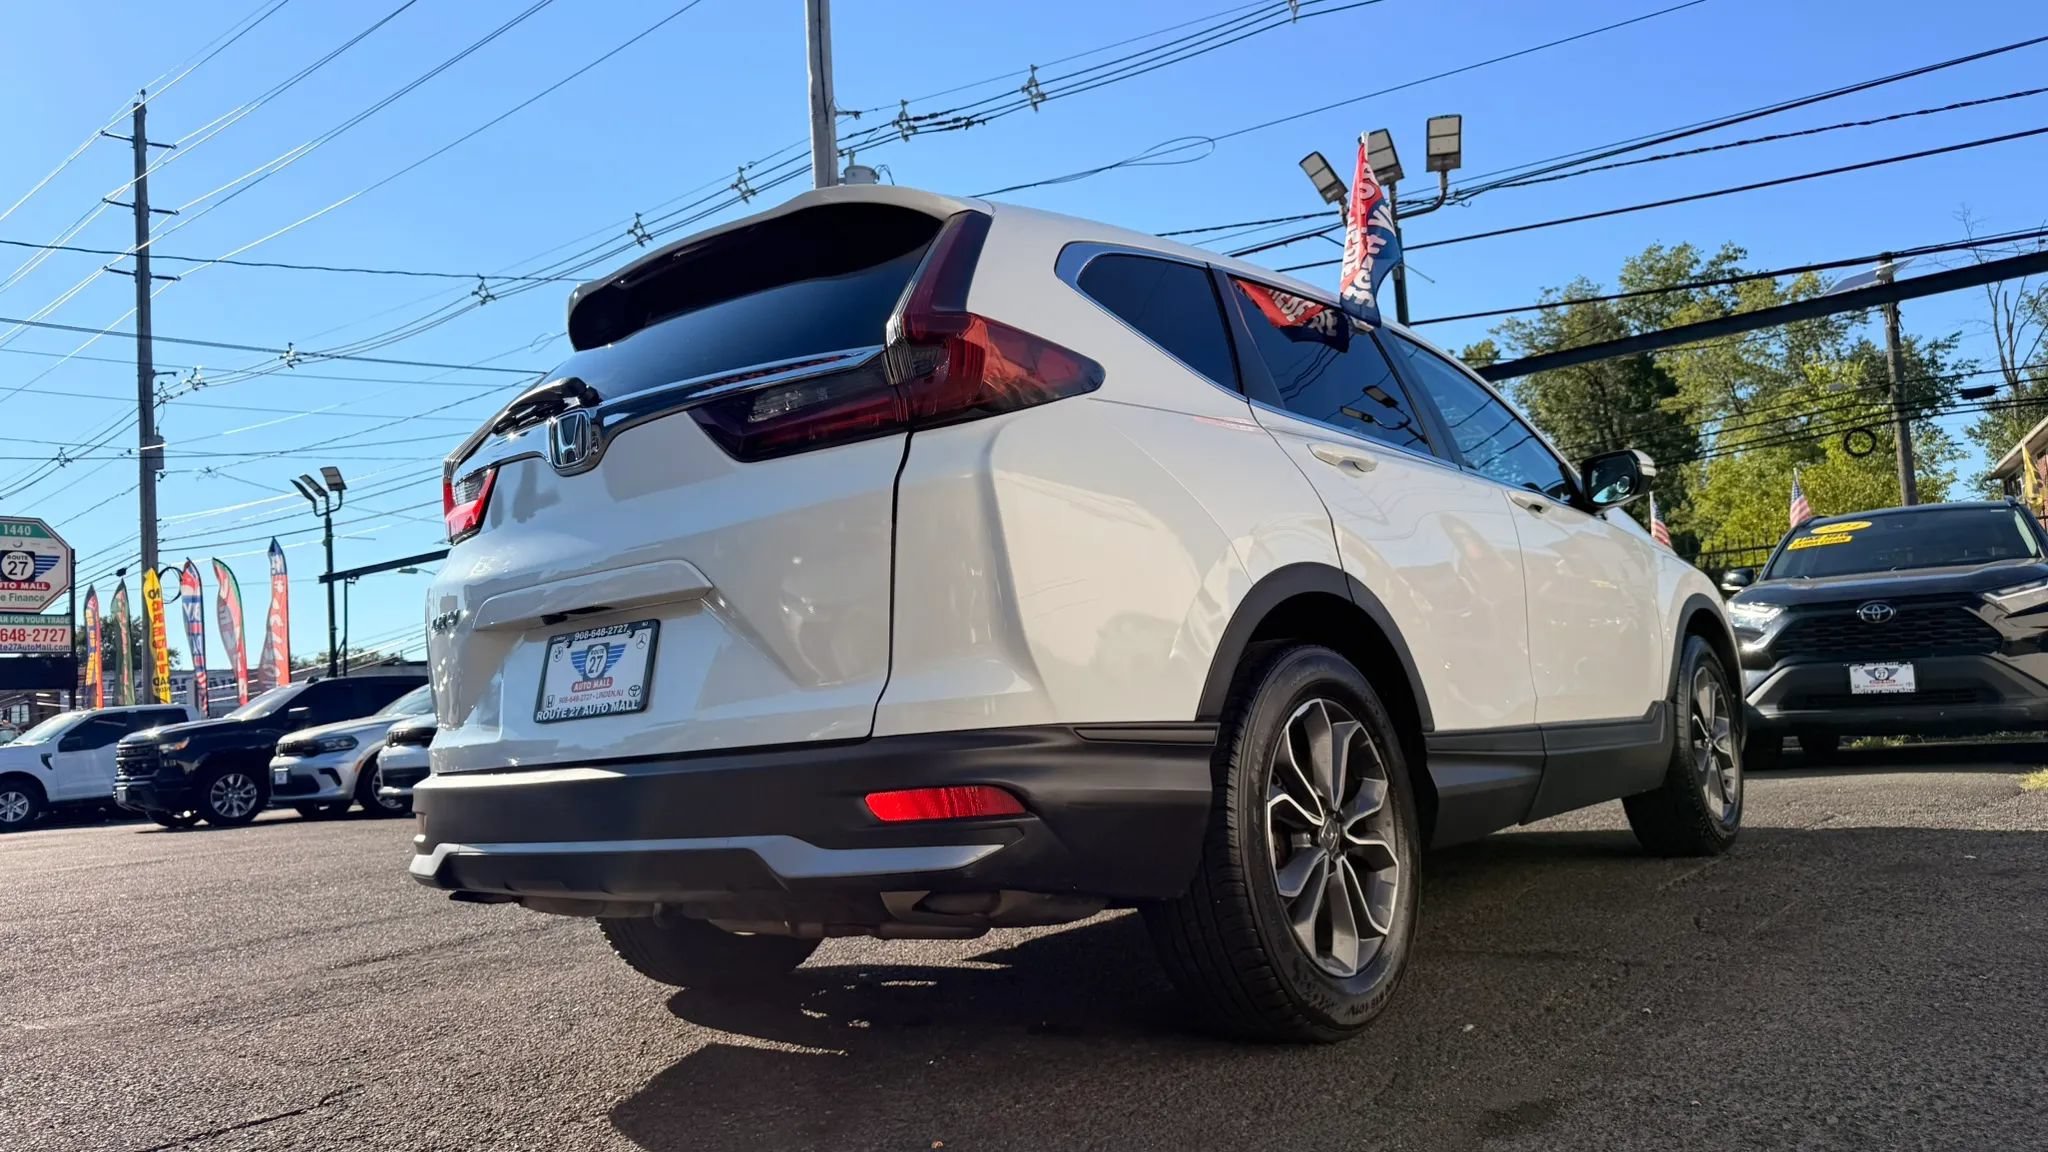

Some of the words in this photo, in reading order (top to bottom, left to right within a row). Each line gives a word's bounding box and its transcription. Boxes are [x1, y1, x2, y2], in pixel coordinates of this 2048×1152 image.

[4, 524, 31, 536] 1440
[8, 561, 28, 576] 27
[9, 592, 45, 601] Finance
[10, 616, 24, 624] FOR
[26, 616, 45, 624] YOUR
[0, 628, 66, 642] 648-2727
[574, 624, 629, 641] 908-648-2727
[590, 648, 605, 656] ROUTE
[588, 655, 603, 674] 27
[573, 682, 591, 691] AUTO
[592, 679, 611, 689] MALL
[536, 709, 570, 721] ROUTE
[570, 707, 581, 717] 27
[582, 703, 608, 715] AUTO
[610, 700, 638, 712] MALL
